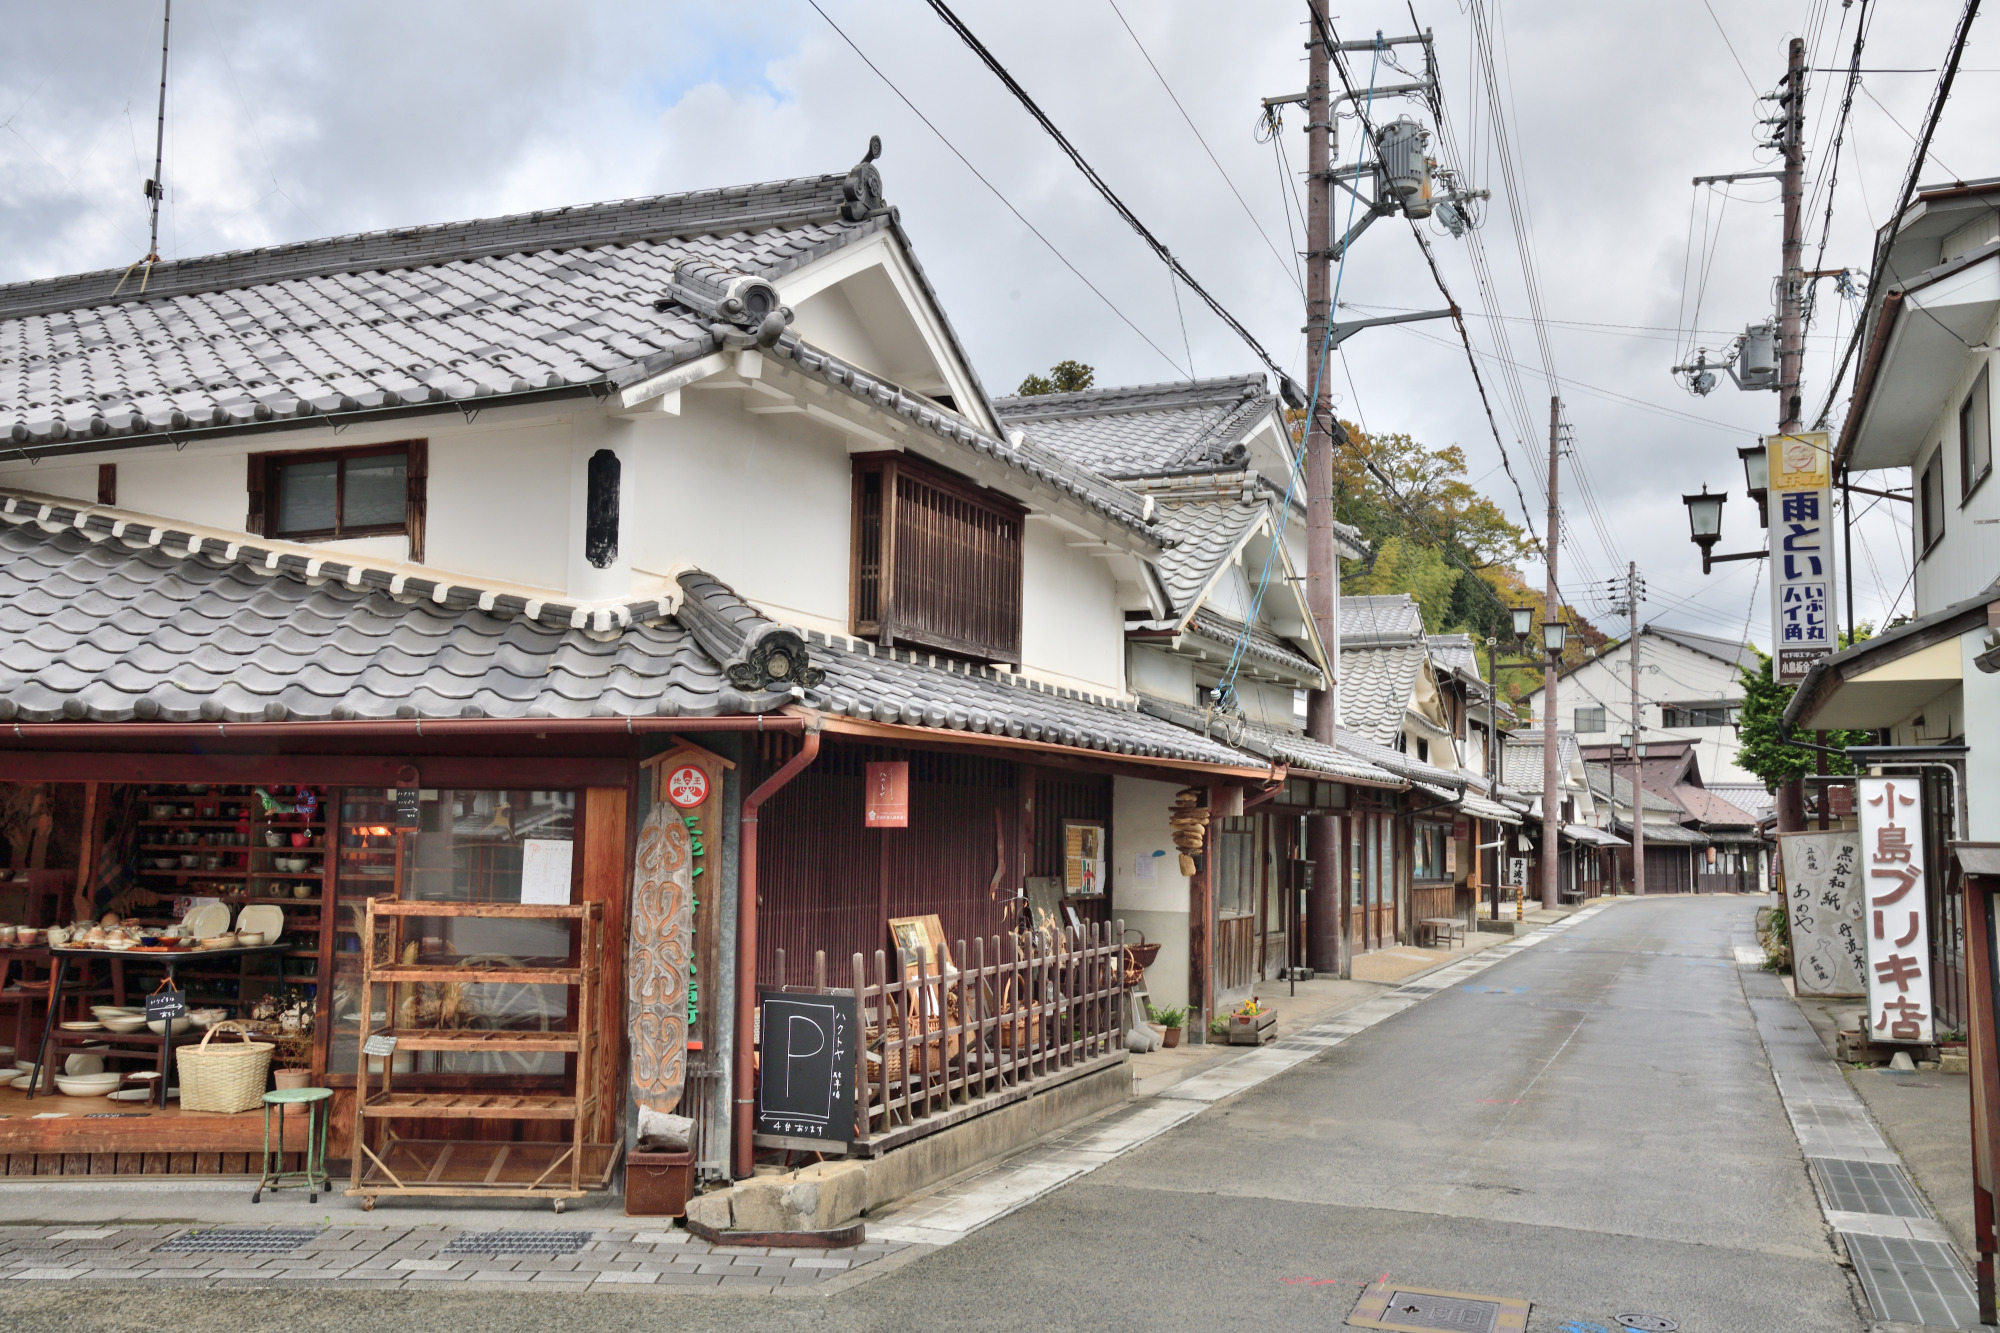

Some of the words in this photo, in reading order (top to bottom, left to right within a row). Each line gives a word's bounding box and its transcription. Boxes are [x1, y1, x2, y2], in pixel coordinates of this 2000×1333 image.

[1782, 491, 1822, 580] 雨とい
[1784, 587, 1802, 640] ハイ角
[1805, 586, 1825, 639] いぶし丸
[1782, 661, 1814, 674] 小島板金
[1820, 845, 1854, 911] 黒谷和紙
[1793, 883, 1814, 934] あめや
[1868, 782, 1927, 1039] 小島ブリキ店
[786, 1015, 825, 1098] P
[834, 1013, 846, 1060] ハクトヤ
